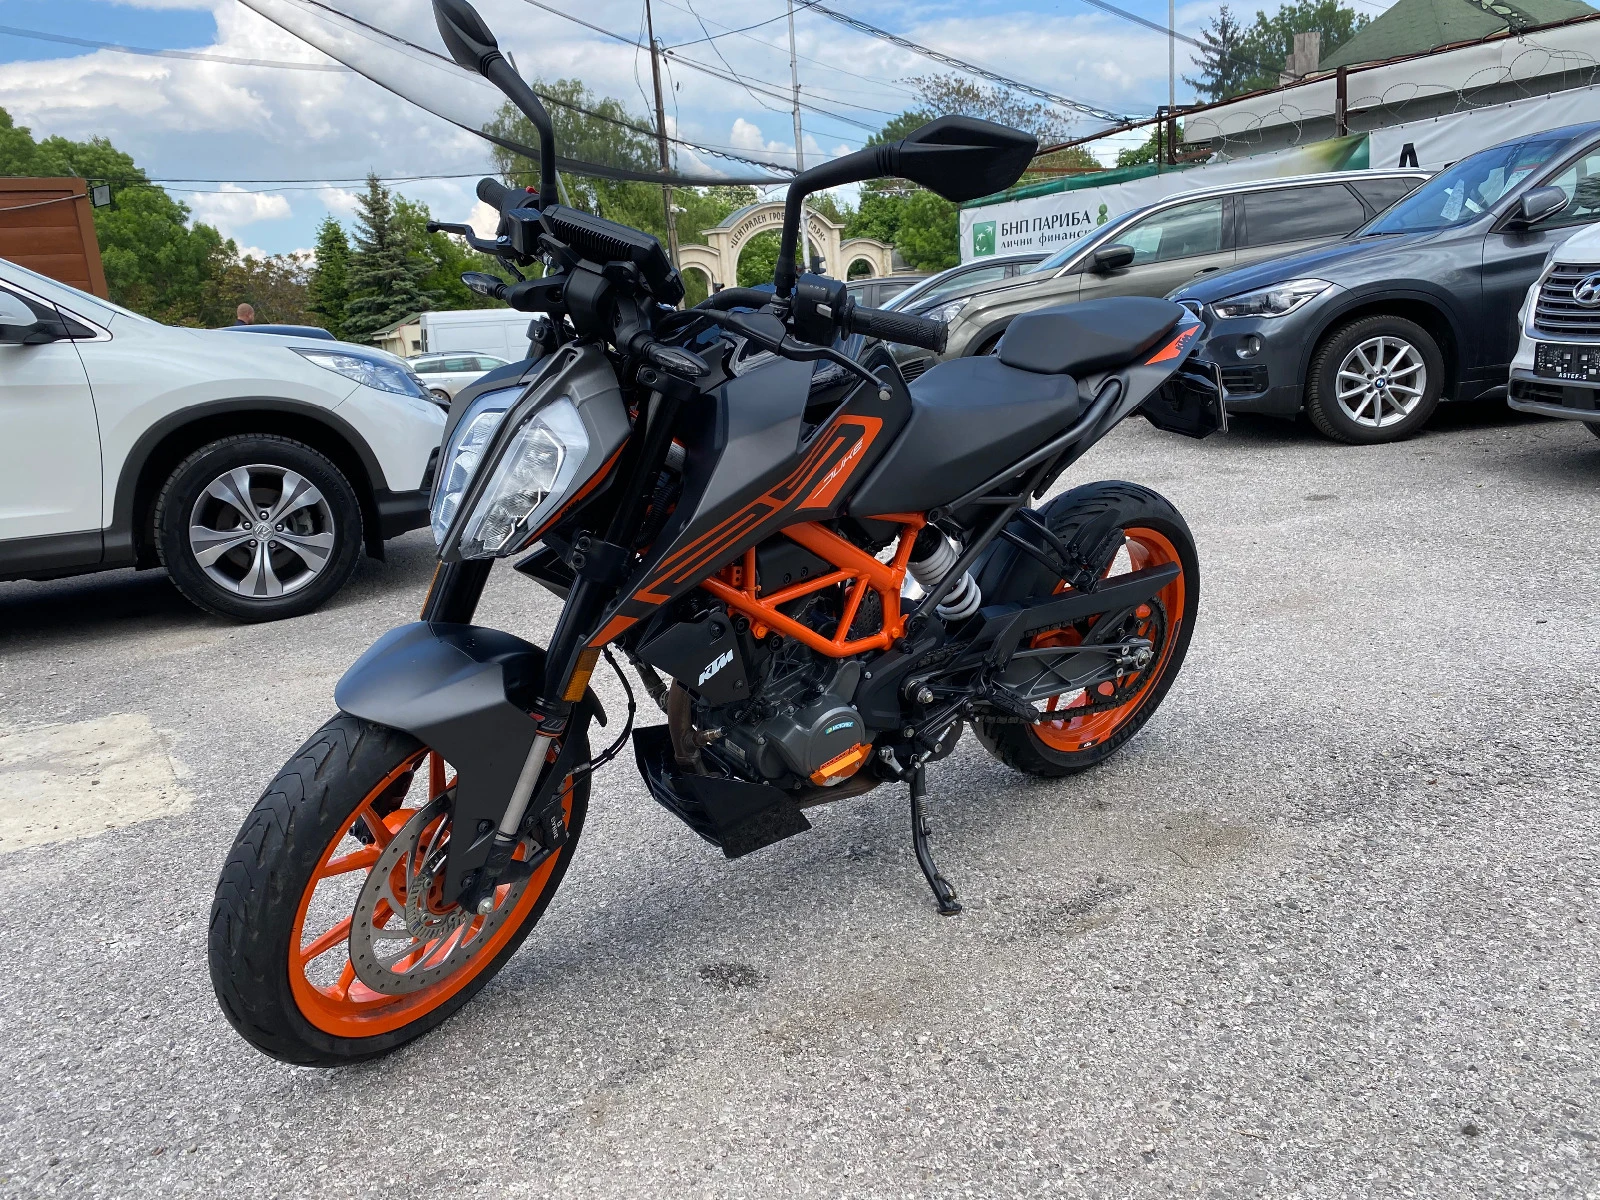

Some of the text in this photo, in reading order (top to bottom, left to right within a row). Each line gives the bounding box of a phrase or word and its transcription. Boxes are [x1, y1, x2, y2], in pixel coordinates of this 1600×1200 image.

[1001, 210, 1091, 237] БНП ПАРИБА
[1000, 237, 1032, 249] лични
[812, 437, 864, 500] DUKE
[698, 648, 734, 687] KTM
